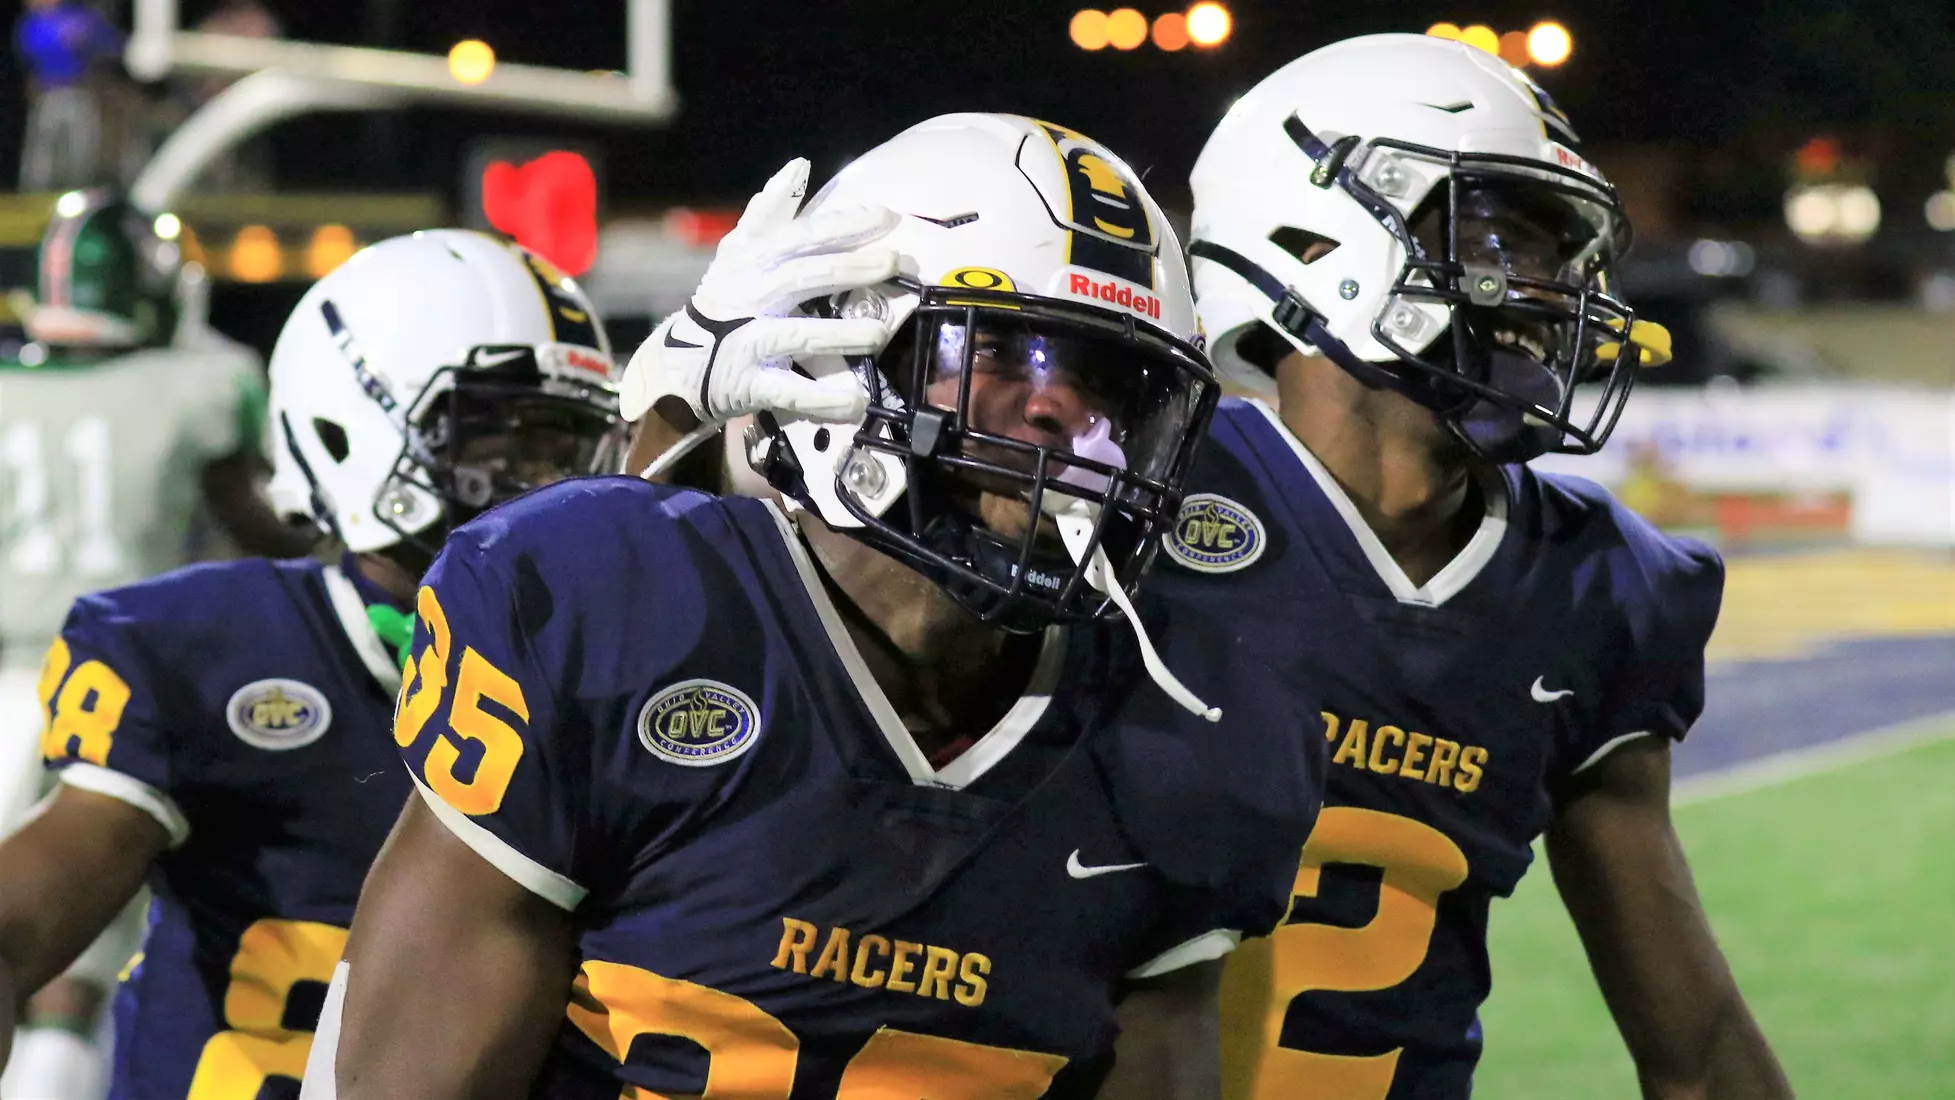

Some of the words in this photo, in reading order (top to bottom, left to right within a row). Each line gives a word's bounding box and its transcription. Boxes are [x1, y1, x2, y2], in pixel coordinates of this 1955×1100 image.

[1070, 273, 1160, 320] Riddell
[1185, 520, 1236, 548] OVC
[253, 701, 303, 727] OVC
[394, 585, 530, 816] 35
[657, 694, 685, 713] OHIO
[705, 691, 746, 713] VALLEY
[668, 709, 726, 738] OVC
[660, 738, 738, 756] CONFERENCE
[770, 917, 992, 1007] RACERS
